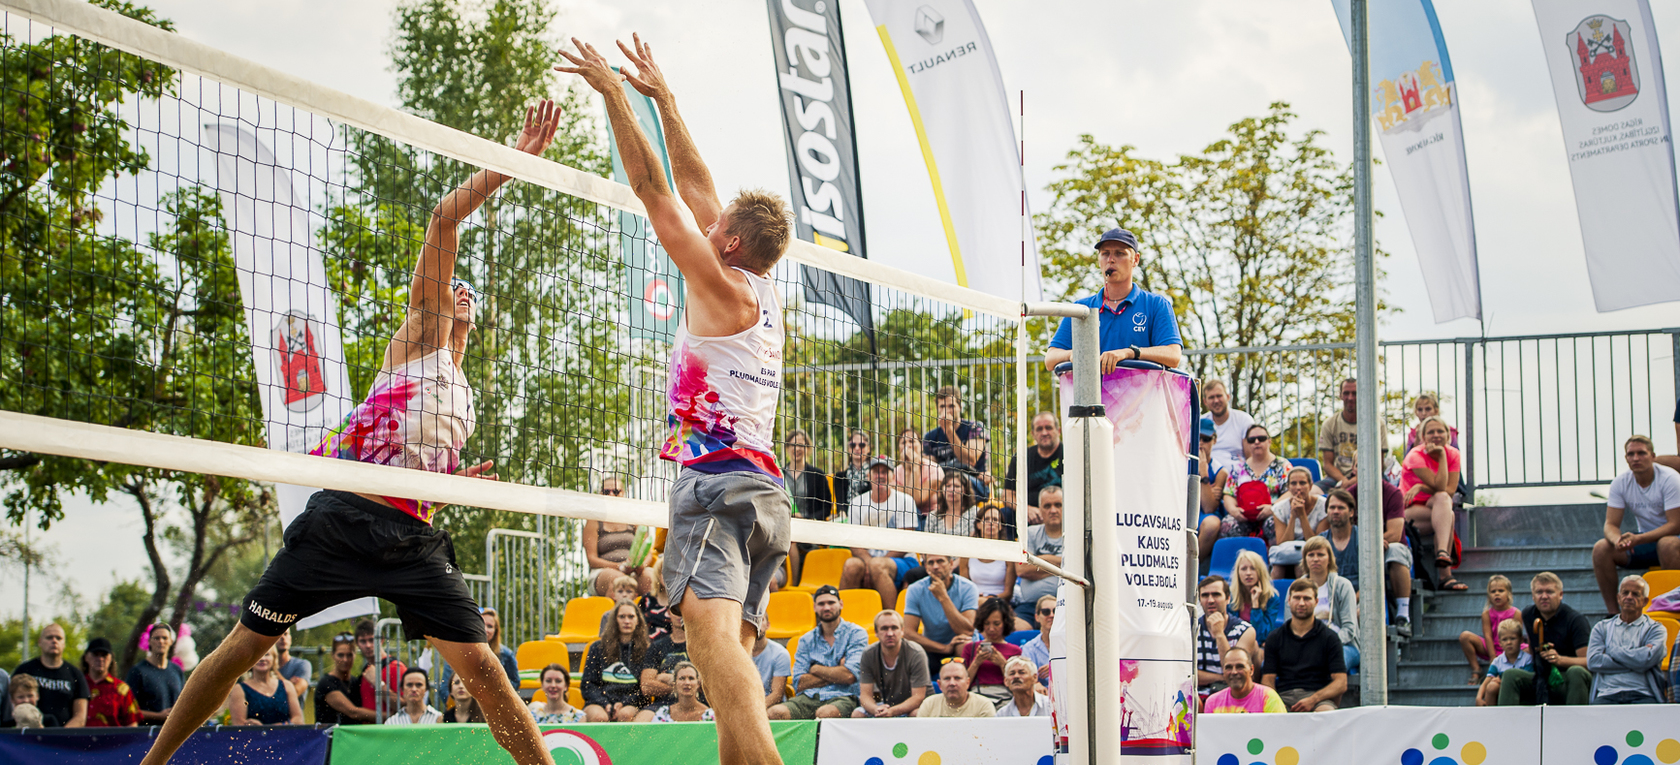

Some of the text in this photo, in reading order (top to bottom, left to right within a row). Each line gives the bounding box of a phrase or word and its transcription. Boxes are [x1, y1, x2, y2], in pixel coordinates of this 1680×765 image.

[779, 0, 847, 239] isostar
[729, 369, 767, 386] PLUDMALES
[1116, 512, 1181, 531] LUCAVSALAS
[1137, 535, 1170, 551] KAUSS
[1121, 553, 1179, 569] PLUDMALES
[1125, 573, 1177, 589] VOLEJBOLĀ
[248, 599, 298, 624] HARALDS
